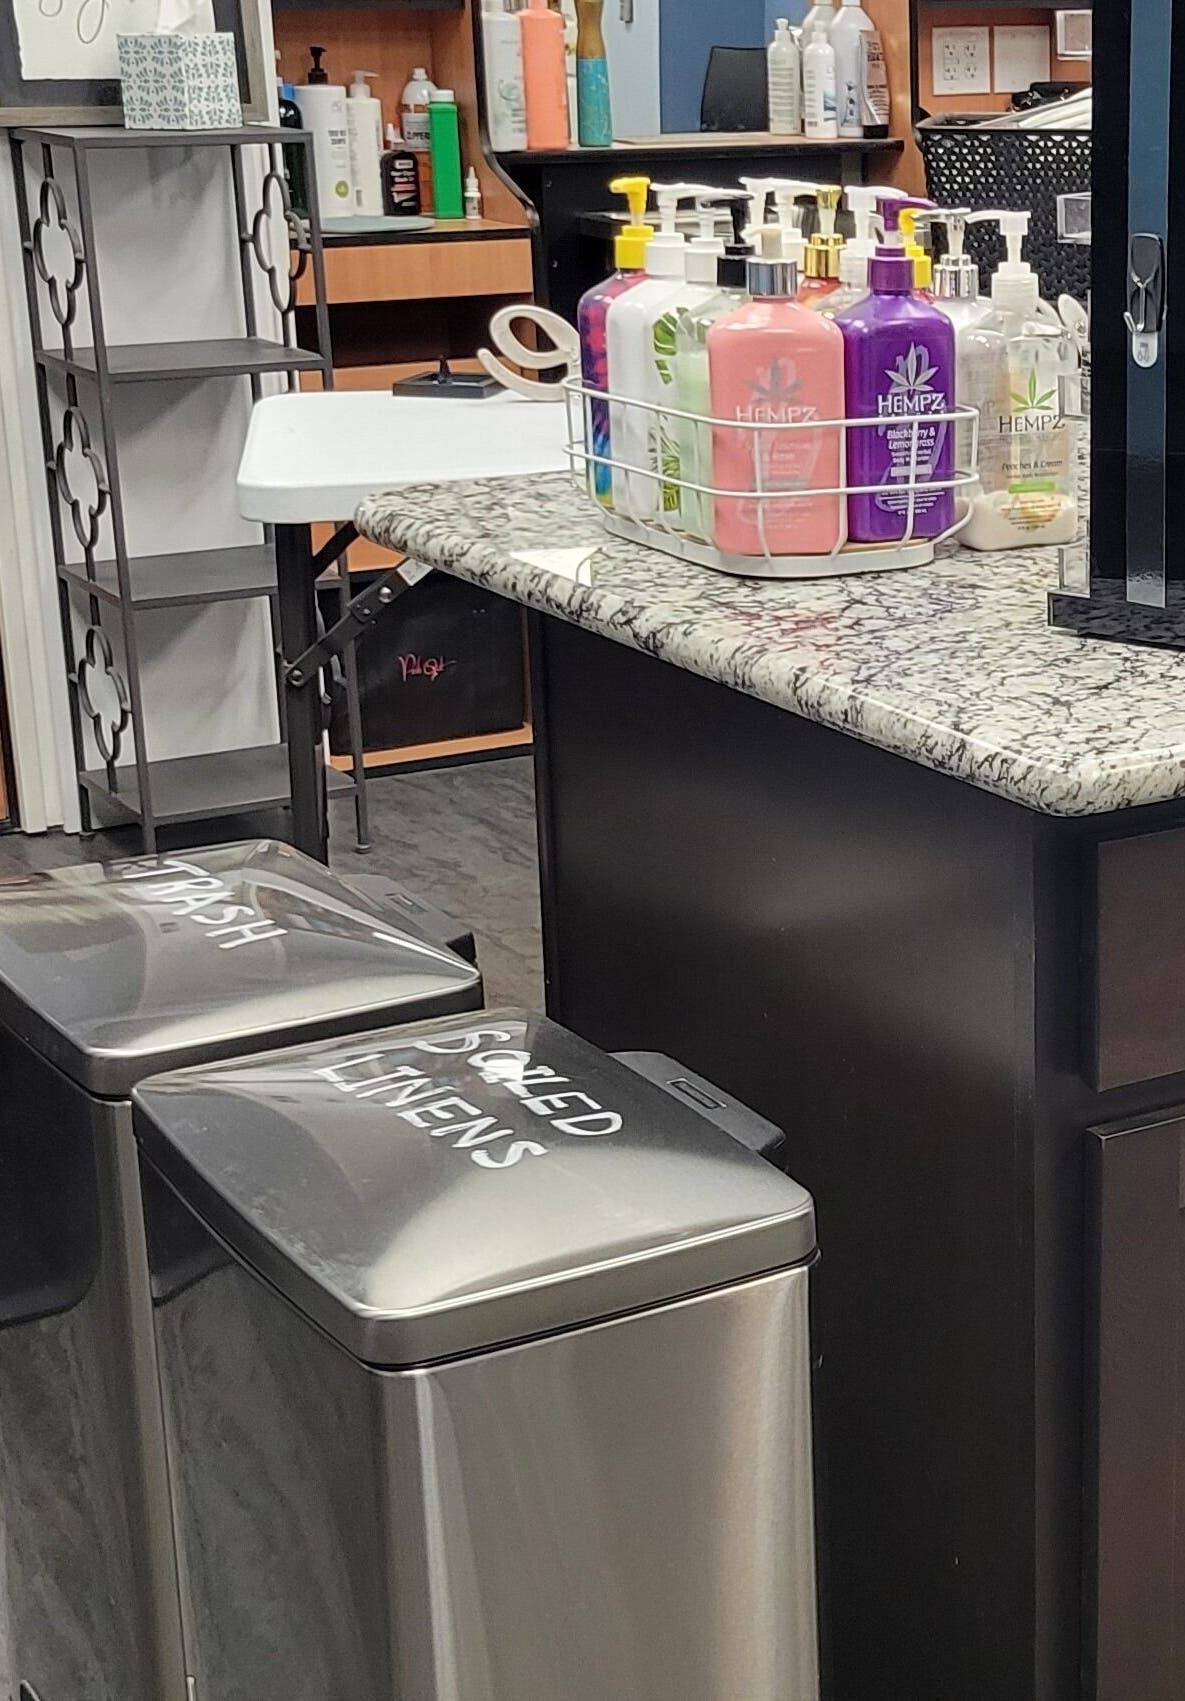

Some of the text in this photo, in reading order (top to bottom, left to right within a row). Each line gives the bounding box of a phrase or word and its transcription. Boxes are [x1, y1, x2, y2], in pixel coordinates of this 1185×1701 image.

[878, 392, 946, 414] HEMPZ
[736, 404, 819, 424] HEMPZ
[999, 414, 1066, 434] HEMPZ
[886, 429, 928, 440] Blackbrry
[888, 439, 934, 450] Lemonrass
[122, 860, 288, 949] TRASH
[413, 1030, 623, 1137] SOILED
[313, 1053, 549, 1169] LINENS
